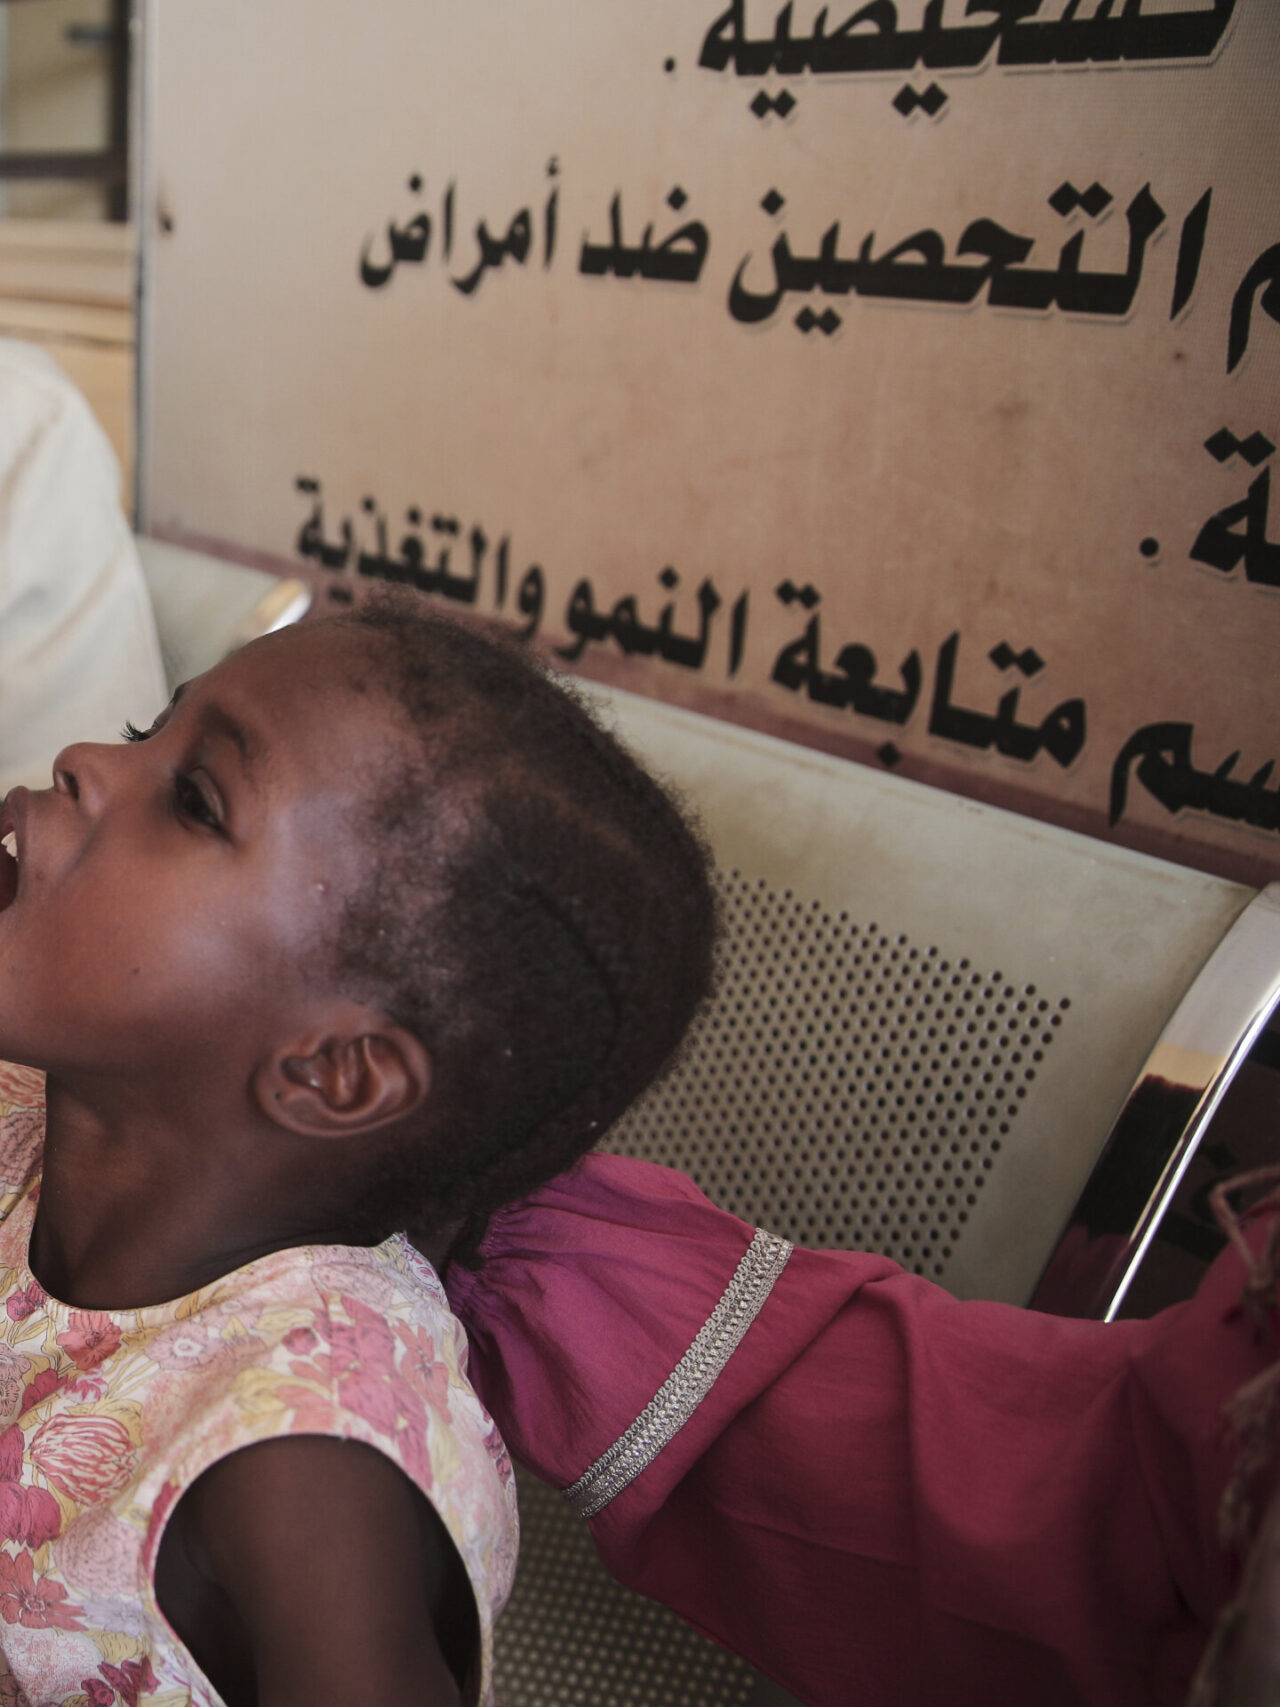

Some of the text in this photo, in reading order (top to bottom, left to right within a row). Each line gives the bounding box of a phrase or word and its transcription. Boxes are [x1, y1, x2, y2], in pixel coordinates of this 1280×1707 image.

[358, 156, 559, 296] أمراض
[578, 184, 710, 284] ضد
[727, 180, 1213, 336] التحصين
[552, 566, 749, 677] النمو
[770, 579, 1087, 770] متابعة
